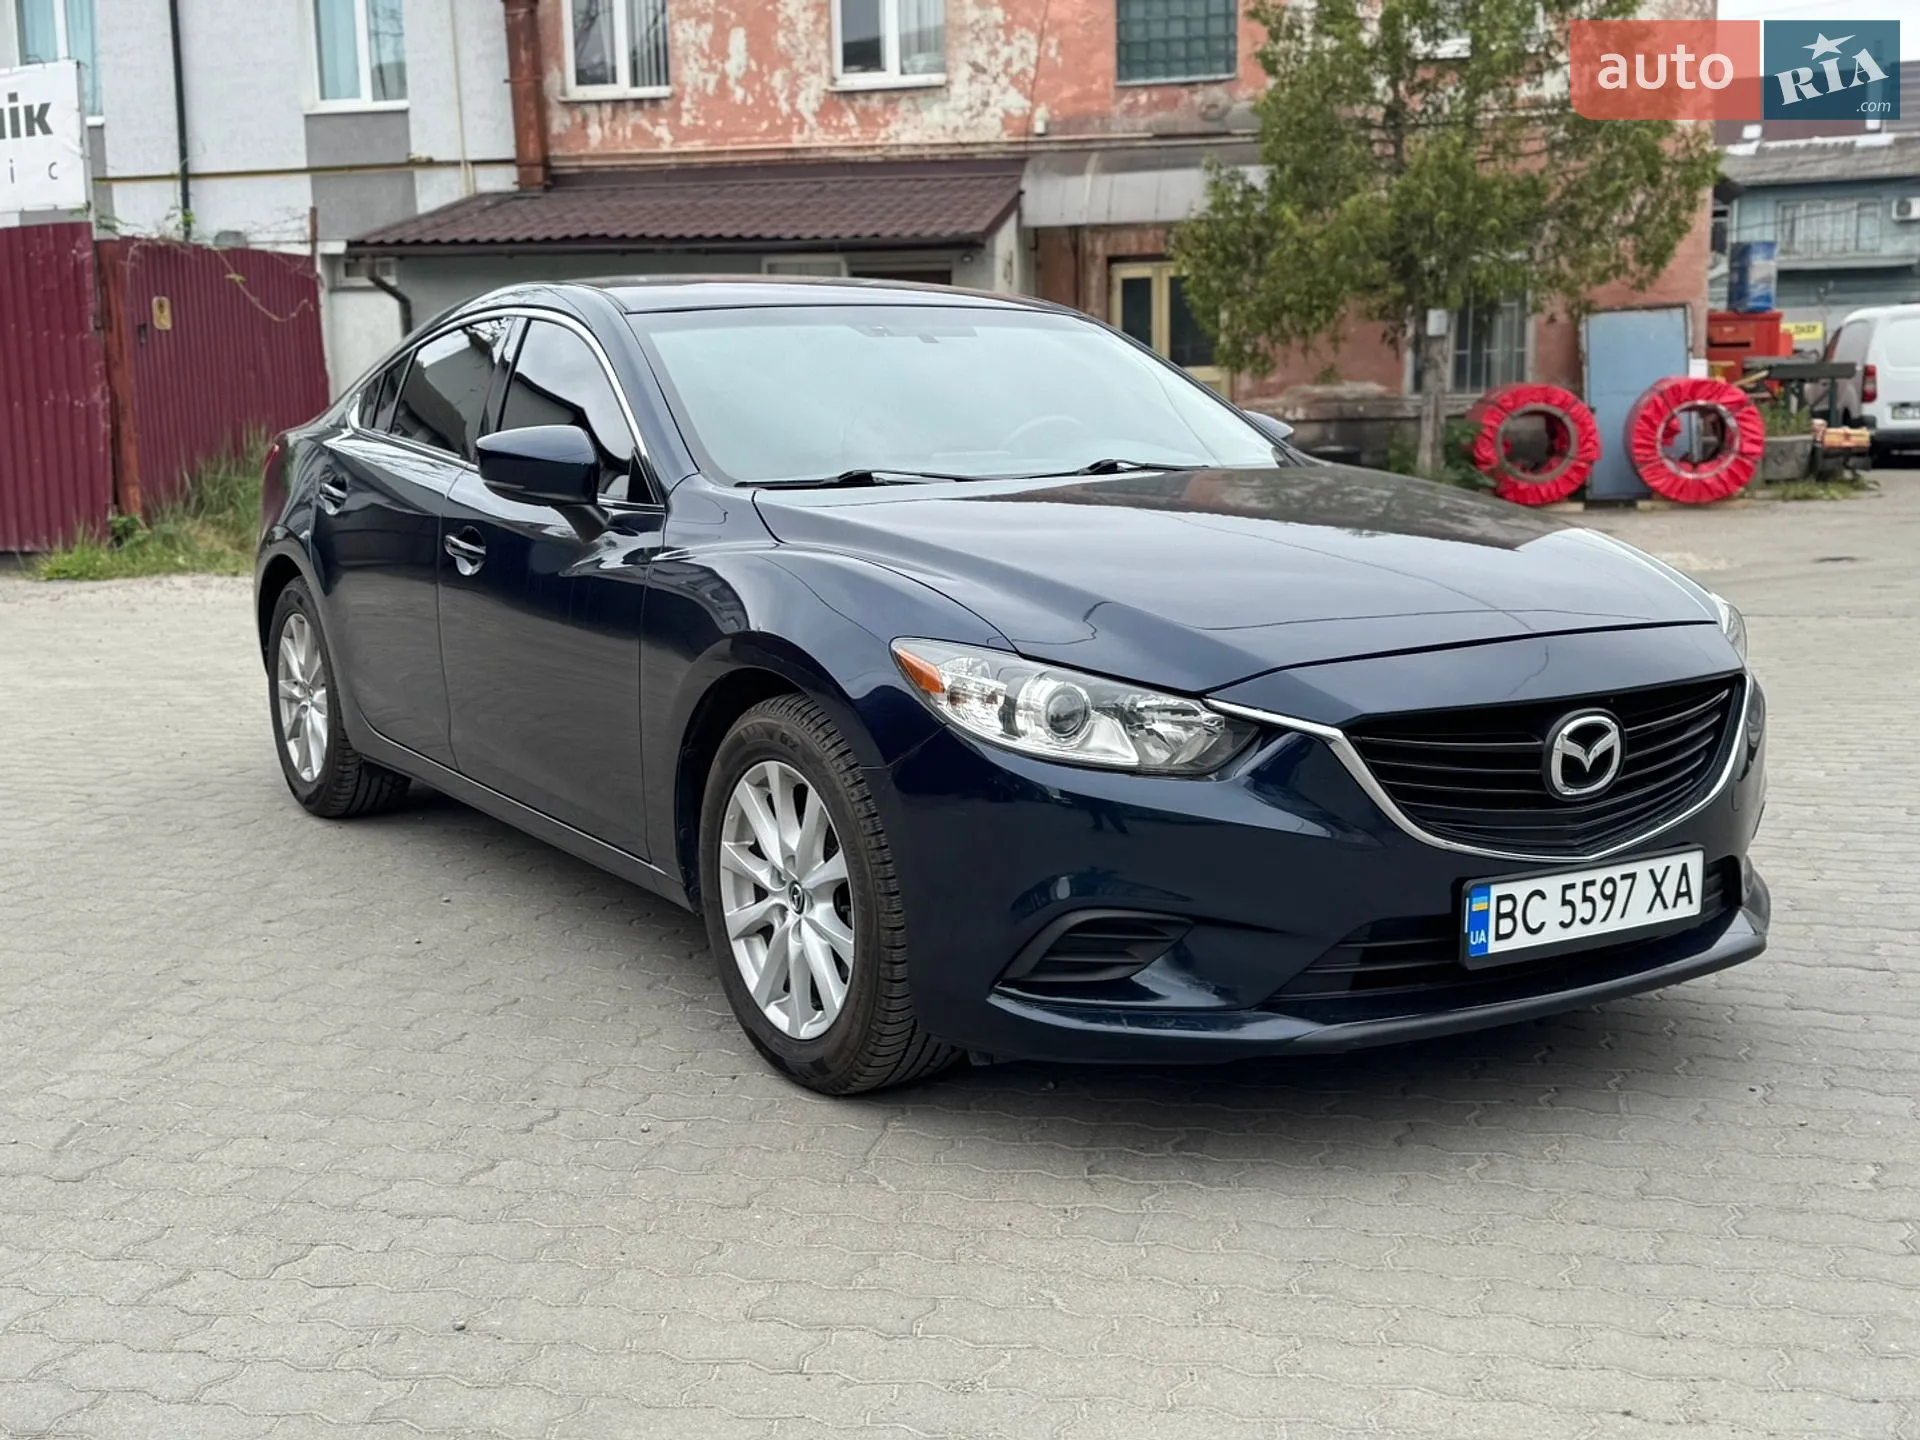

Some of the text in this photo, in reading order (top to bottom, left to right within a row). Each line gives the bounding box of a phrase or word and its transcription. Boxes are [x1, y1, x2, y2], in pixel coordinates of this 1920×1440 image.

[1495, 862, 1693, 941] BC 5597 XA
[1470, 929, 1487, 945] UA
